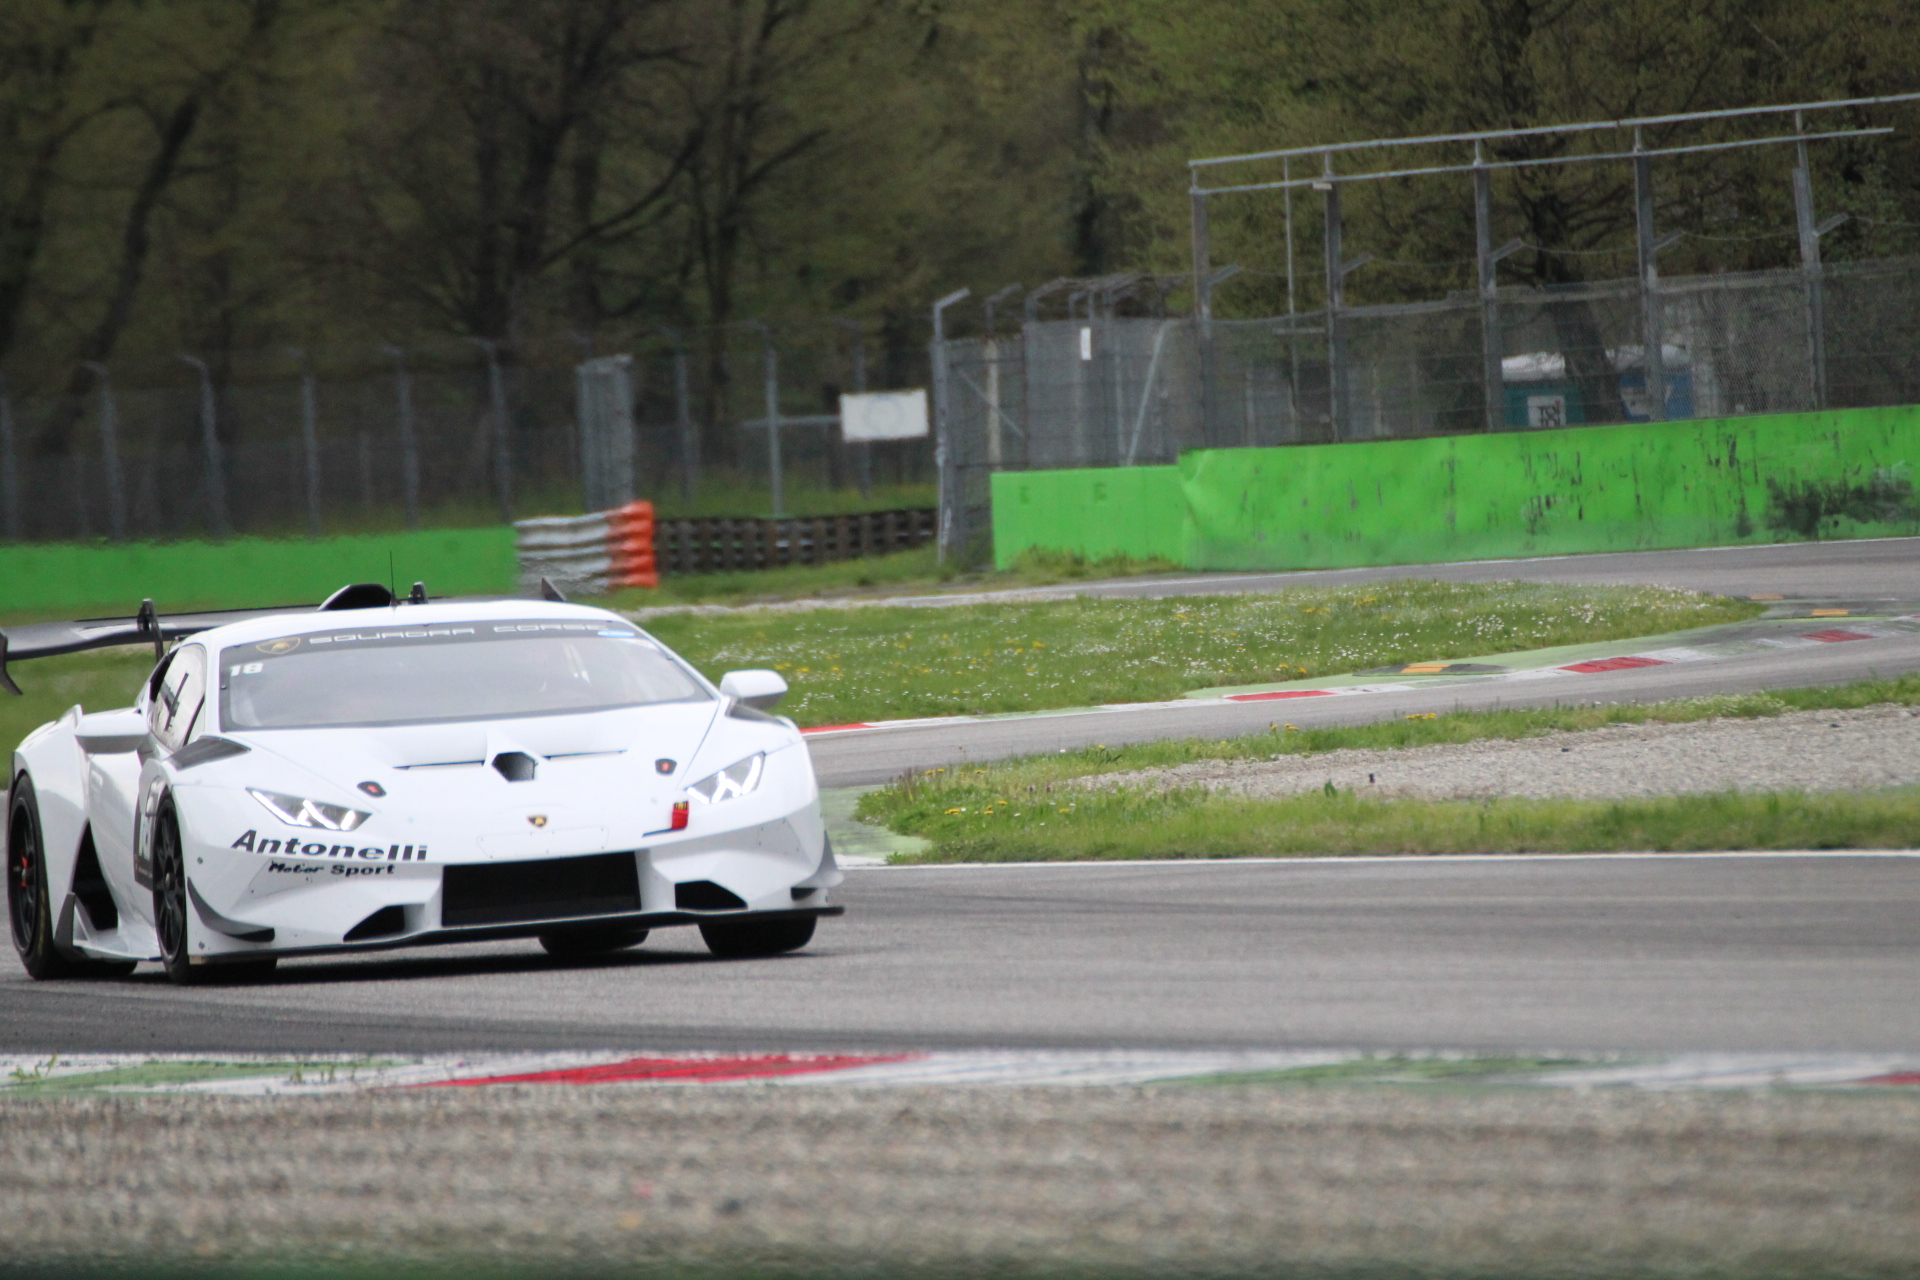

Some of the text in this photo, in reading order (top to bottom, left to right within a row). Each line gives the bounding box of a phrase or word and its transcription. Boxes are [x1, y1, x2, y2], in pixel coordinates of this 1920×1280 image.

[309, 627, 476, 645] SQUADRA
[230, 662, 264, 677] 18
[230, 829, 428, 861] Antonelli
[267, 860, 396, 877] Motor Sport
